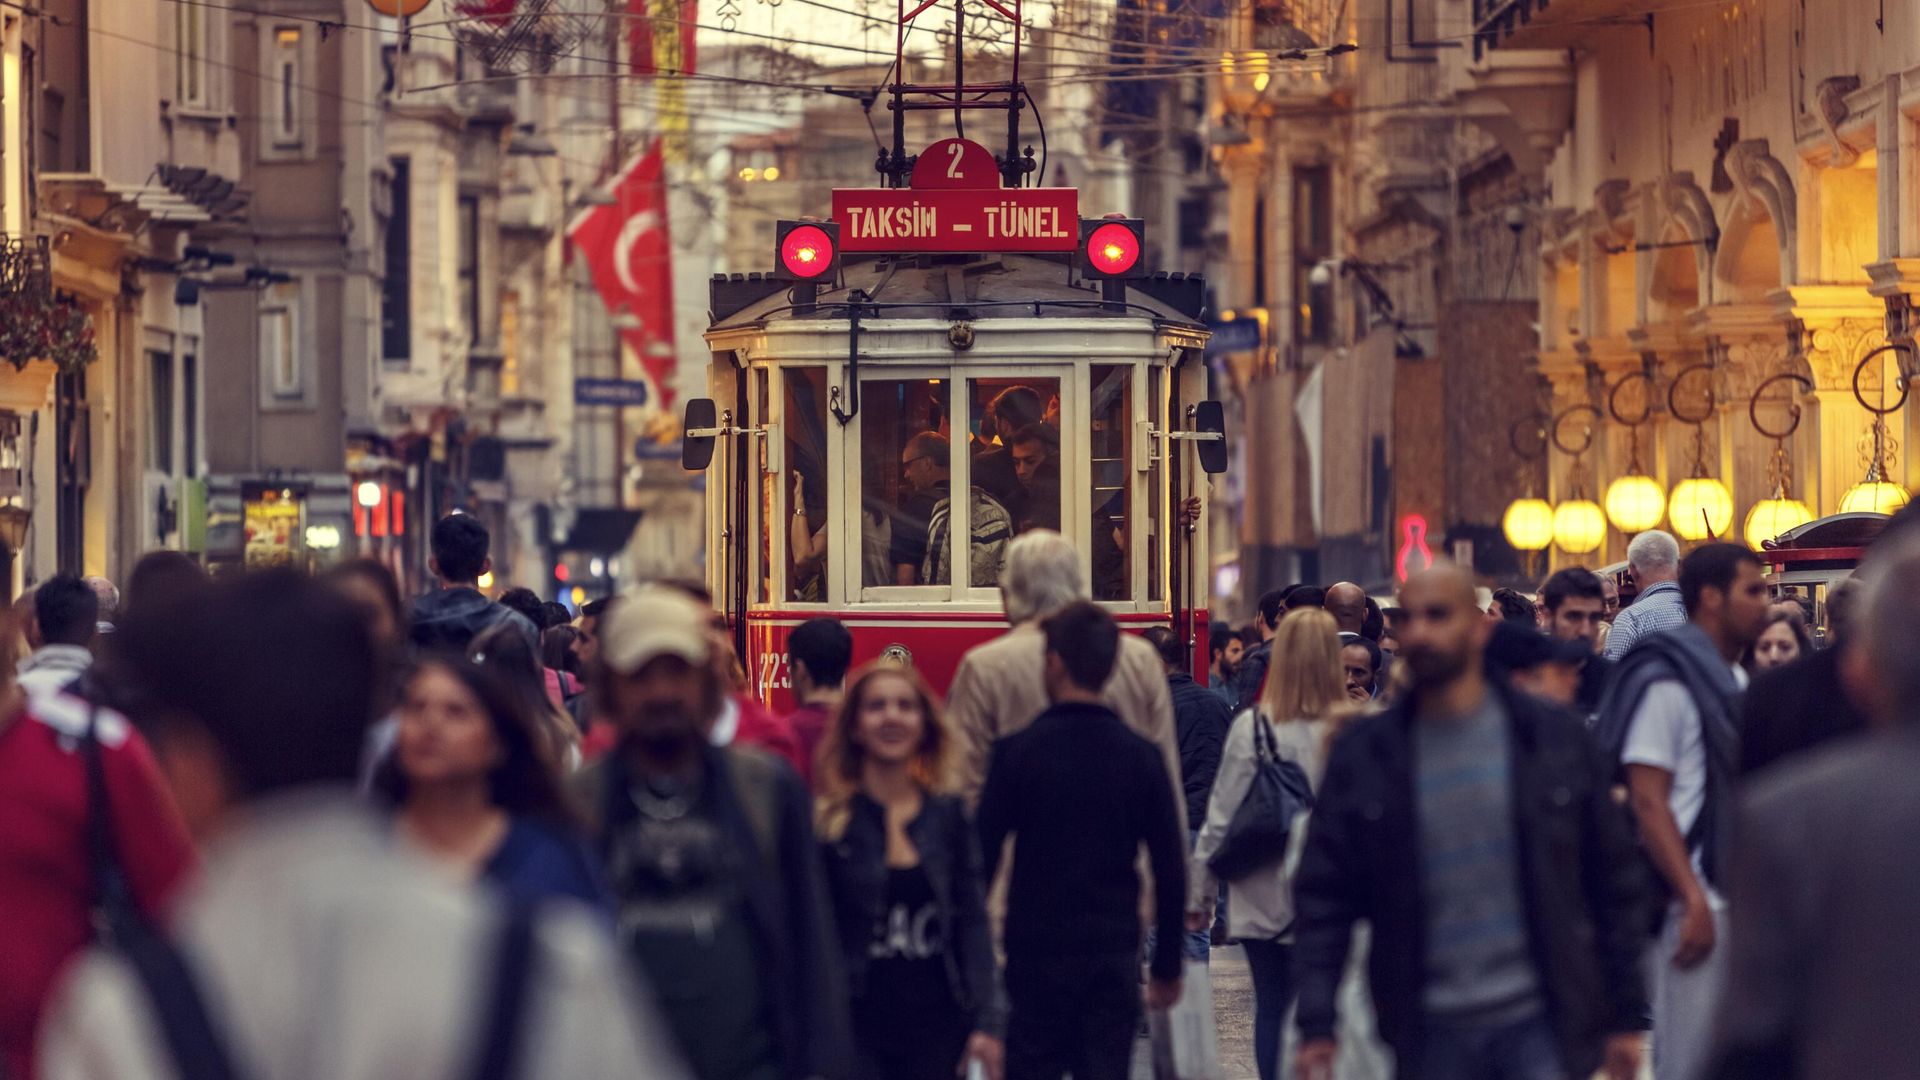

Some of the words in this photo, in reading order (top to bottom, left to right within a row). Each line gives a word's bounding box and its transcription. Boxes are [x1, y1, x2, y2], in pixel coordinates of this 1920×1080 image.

[947, 143, 964, 179] 2
[847, 201, 937, 238] TAKSİM
[984, 201, 1069, 238] TÜNEL
